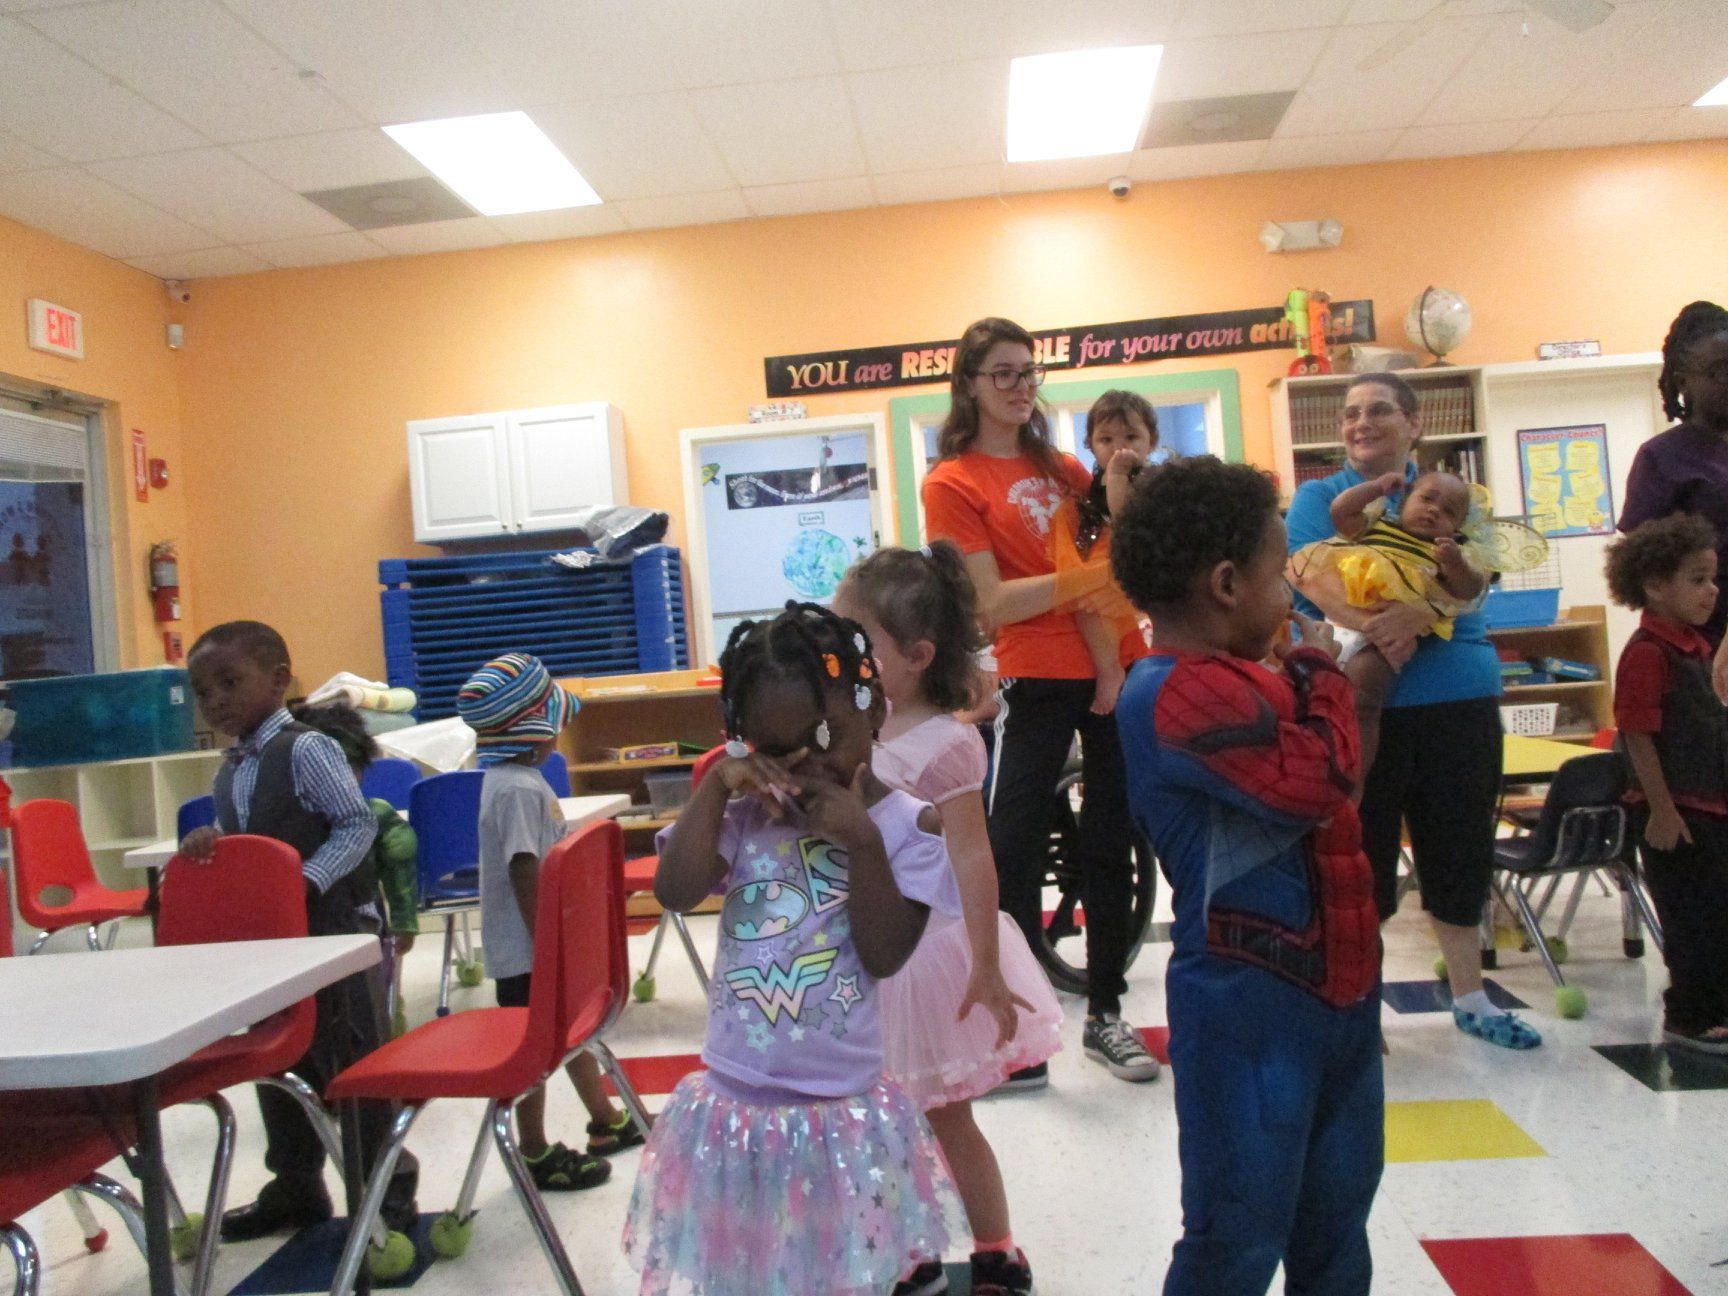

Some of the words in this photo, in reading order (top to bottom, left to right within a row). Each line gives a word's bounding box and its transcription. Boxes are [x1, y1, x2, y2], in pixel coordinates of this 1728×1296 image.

[46, 308, 76, 351] EXIT
[786, 360, 849, 390] YOU
[854, 362, 893, 384] are
[900, 335, 1071, 379] RESBLE
[1076, 333, 1117, 368] for
[1120, 331, 1182, 363] your
[1185, 326, 1243, 350] own
[1249, 308, 1355, 344] acts!
